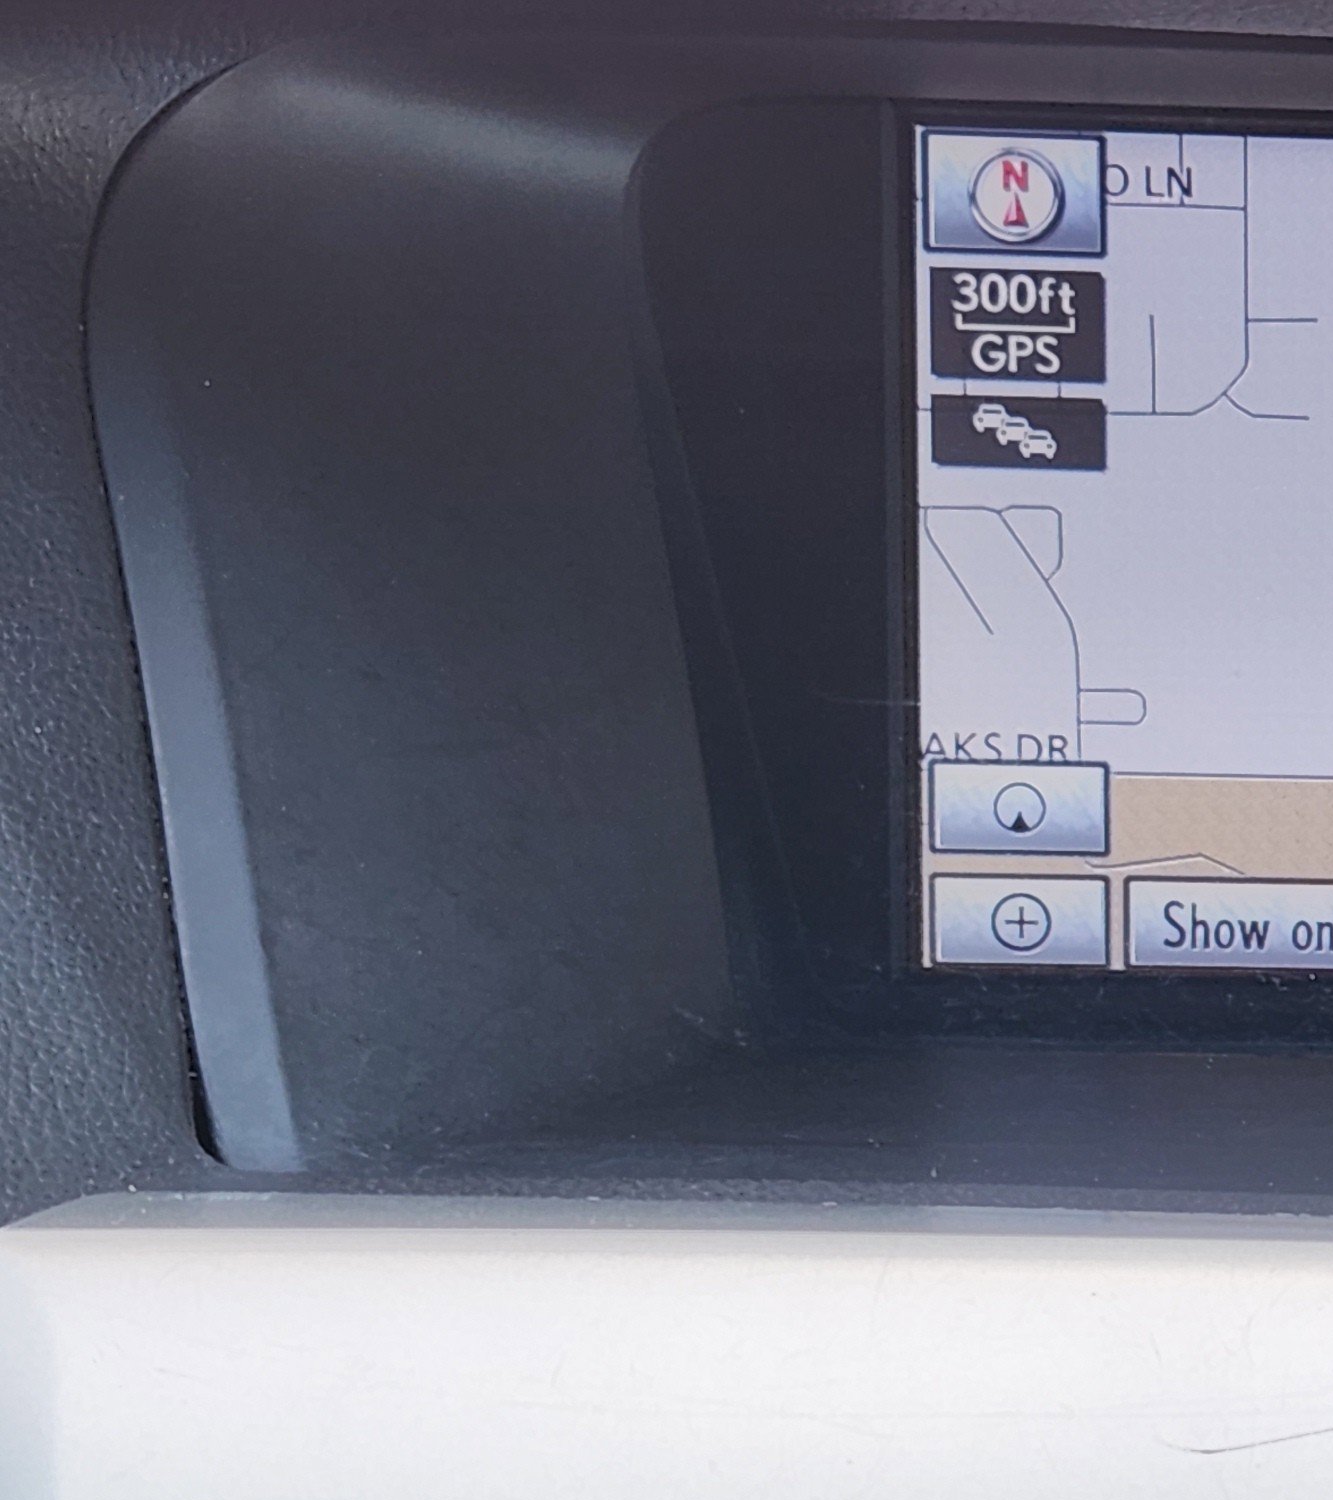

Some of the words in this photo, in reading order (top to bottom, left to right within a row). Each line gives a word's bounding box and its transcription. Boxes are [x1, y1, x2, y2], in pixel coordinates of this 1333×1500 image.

[1002, 158, 1028, 192] N
[1144, 165, 1193, 198] LN
[952, 272, 1076, 316] 300ft
[970, 333, 1061, 375] GPS
[923, 731, 1003, 760] AKS
[1016, 733, 1069, 761] DR
[1162, 901, 1271, 952] Show
